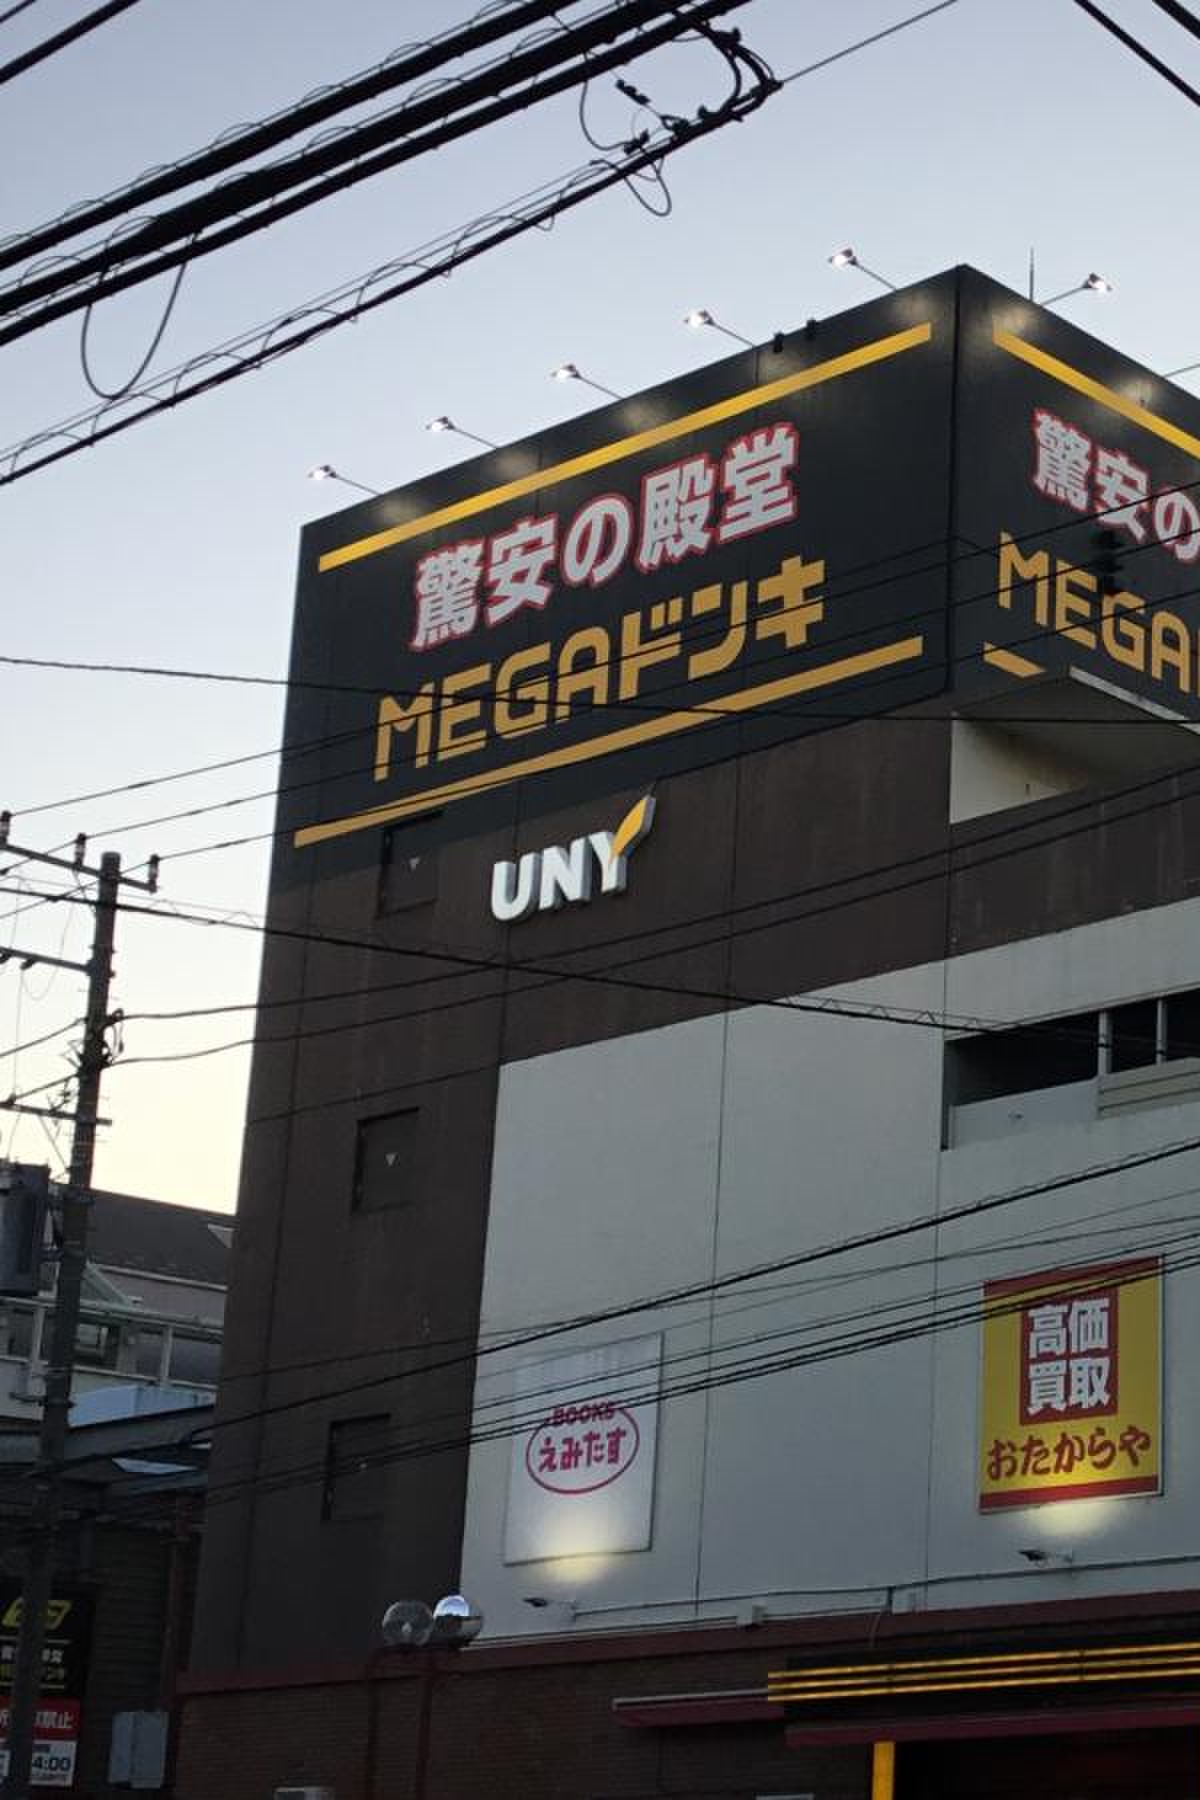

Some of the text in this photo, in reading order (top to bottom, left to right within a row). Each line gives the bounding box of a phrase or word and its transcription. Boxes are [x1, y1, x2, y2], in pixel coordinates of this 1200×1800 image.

[409, 423, 800, 652] 驚安の殿堂
[373, 554, 825, 783] MEGAドンキ
[490, 794, 656, 922] UNY
[1028, 1297, 1111, 1358] 高価
[1027, 1356, 1111, 1415] 買取
[538, 1426, 627, 1473] えみたす
[986, 1424, 1151, 1481] おたからや
